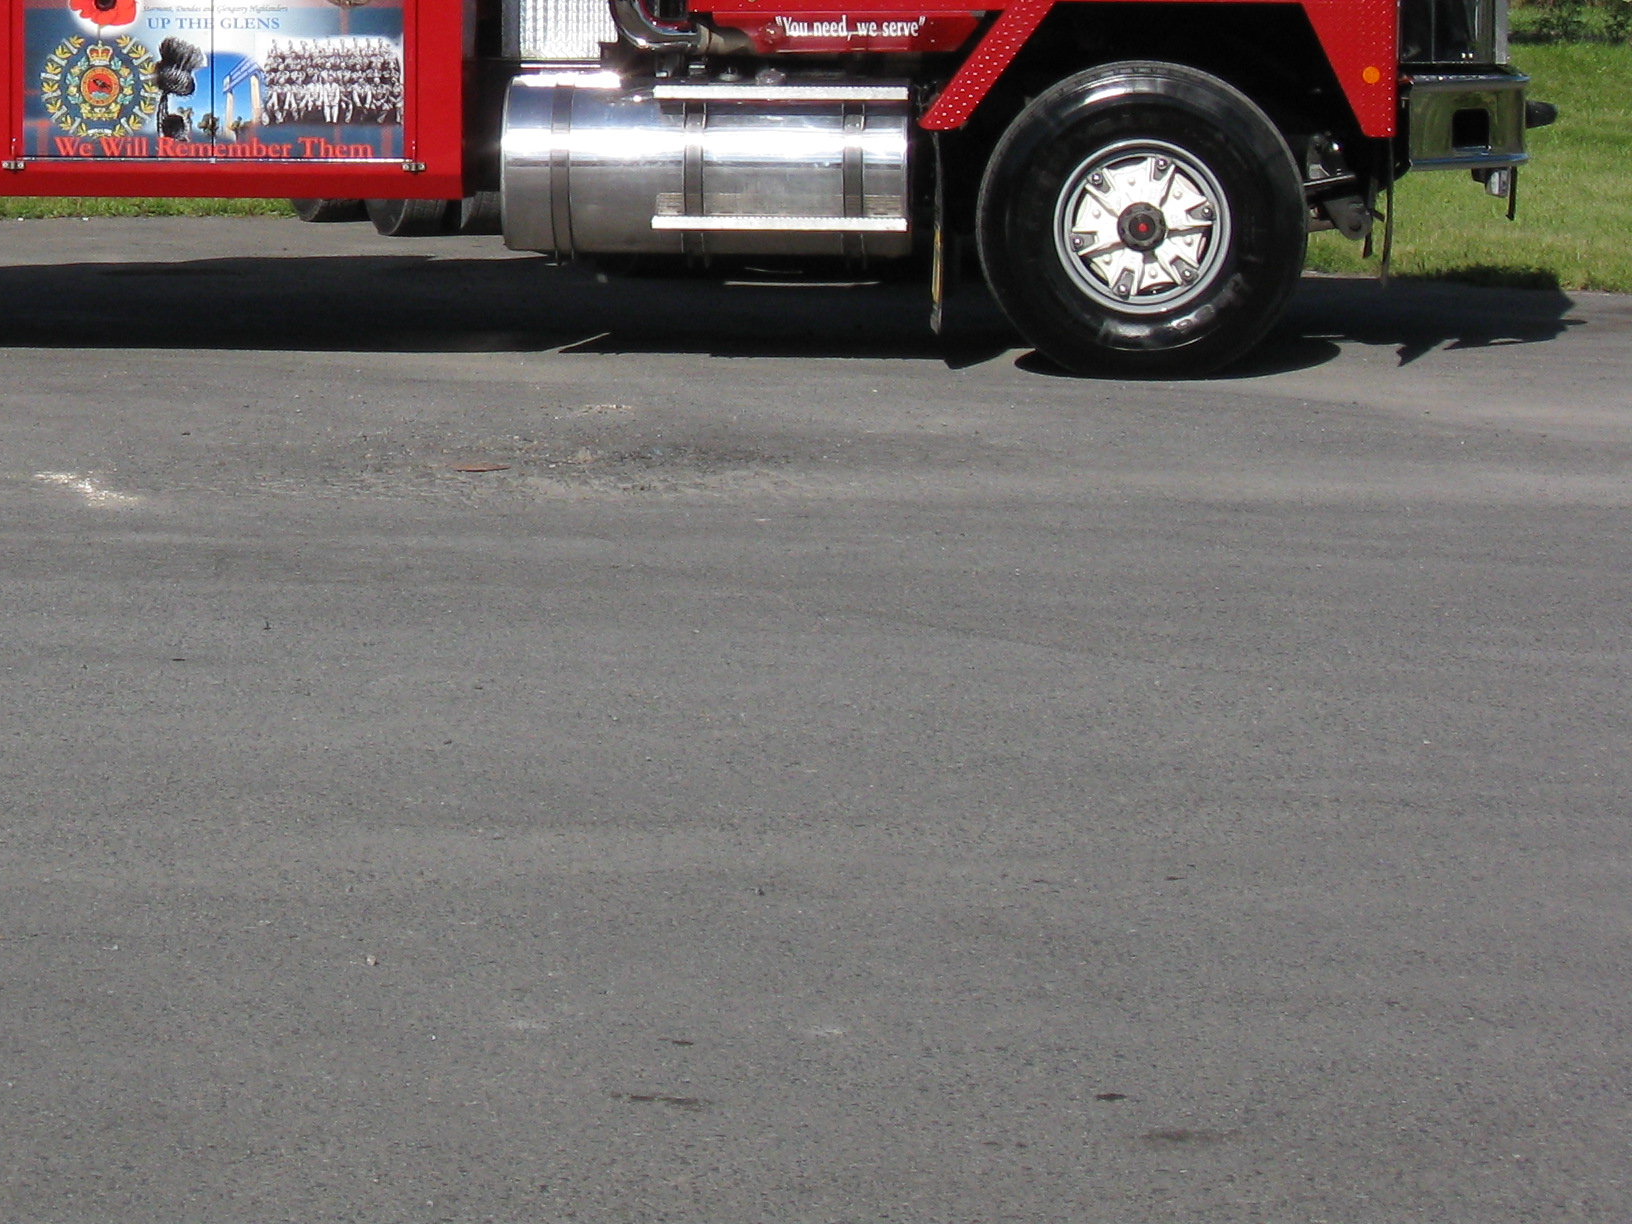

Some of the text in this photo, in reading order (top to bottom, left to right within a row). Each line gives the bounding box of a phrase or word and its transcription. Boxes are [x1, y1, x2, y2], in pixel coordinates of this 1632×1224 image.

[147, 17, 280, 30] UP THE GLENS
[813, 14, 852, 41] need,
[856, 21, 878, 37] we
[54, 136, 374, 159] We Will Remember Them
